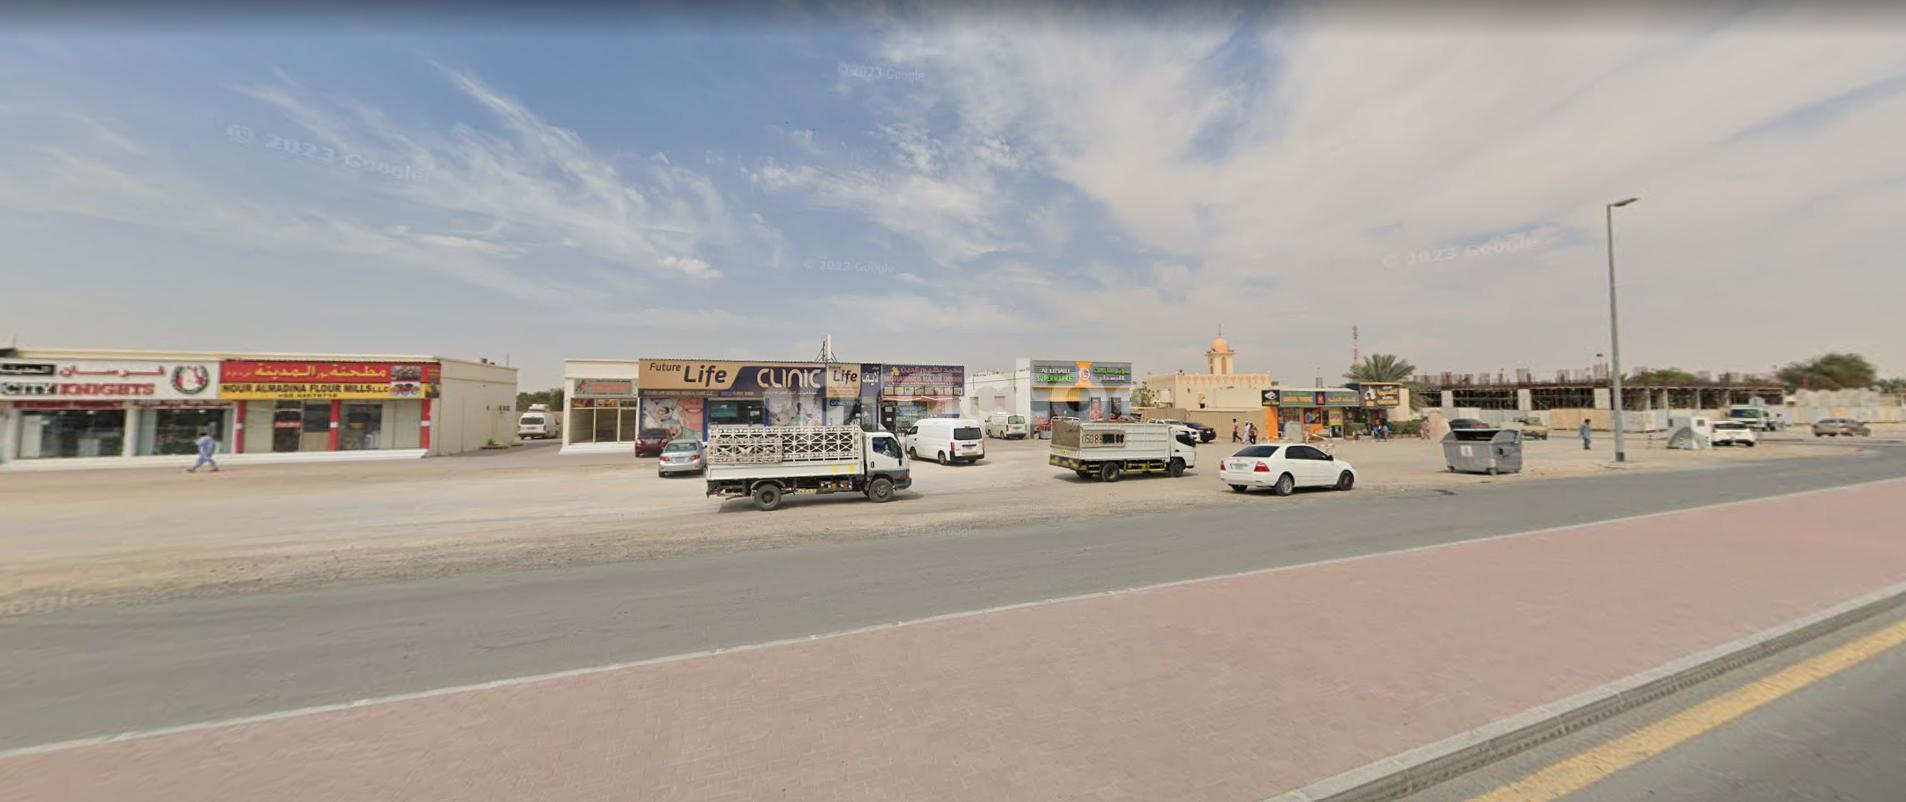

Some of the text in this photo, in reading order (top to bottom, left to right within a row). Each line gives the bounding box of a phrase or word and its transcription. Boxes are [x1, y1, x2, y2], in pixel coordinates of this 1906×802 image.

[253, 362, 315, 381] المدينة
[329, 363, 387, 377] مطحنة
[649, 362, 821, 389] Future Life CLINIC
[833, 369, 858, 385] Life
[60, 383, 155, 395] KNIGHTS
[223, 384, 252, 393] NOUR
[255, 384, 307, 393] ALMADINA
[309, 384, 340, 393] FLOUR
[343, 384, 371, 393] MILLS
